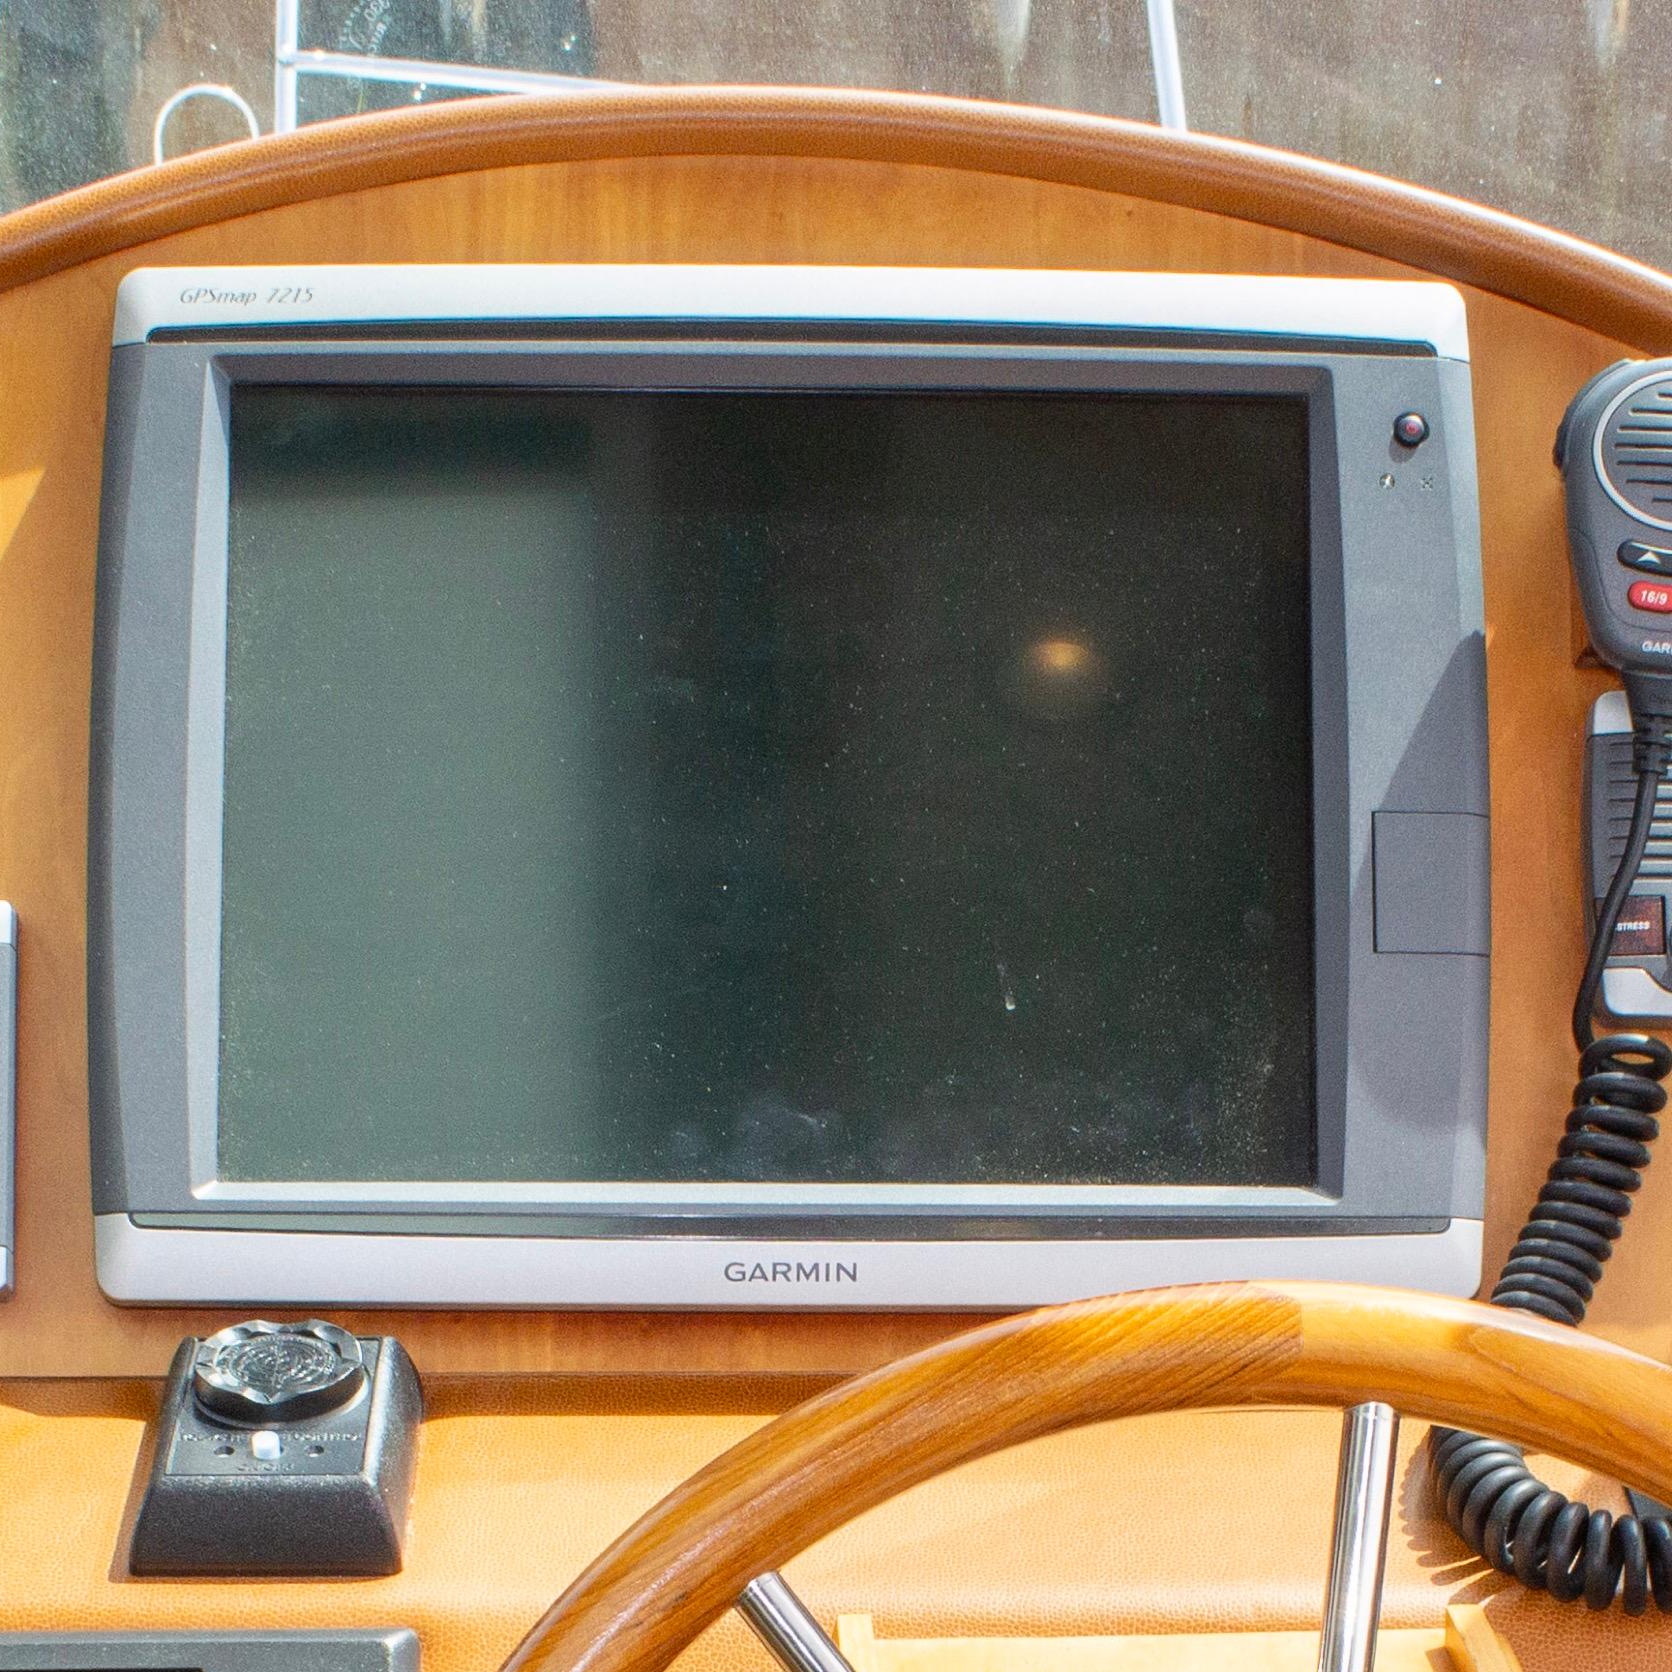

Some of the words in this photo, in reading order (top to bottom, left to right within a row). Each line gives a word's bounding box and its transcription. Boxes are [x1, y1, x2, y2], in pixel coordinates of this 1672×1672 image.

[268, 287, 315, 304] 7215
[1640, 590, 1669, 605] 16/9
[1615, 921, 1651, 932] STRESS
[723, 1261, 858, 1283] GARMIN
